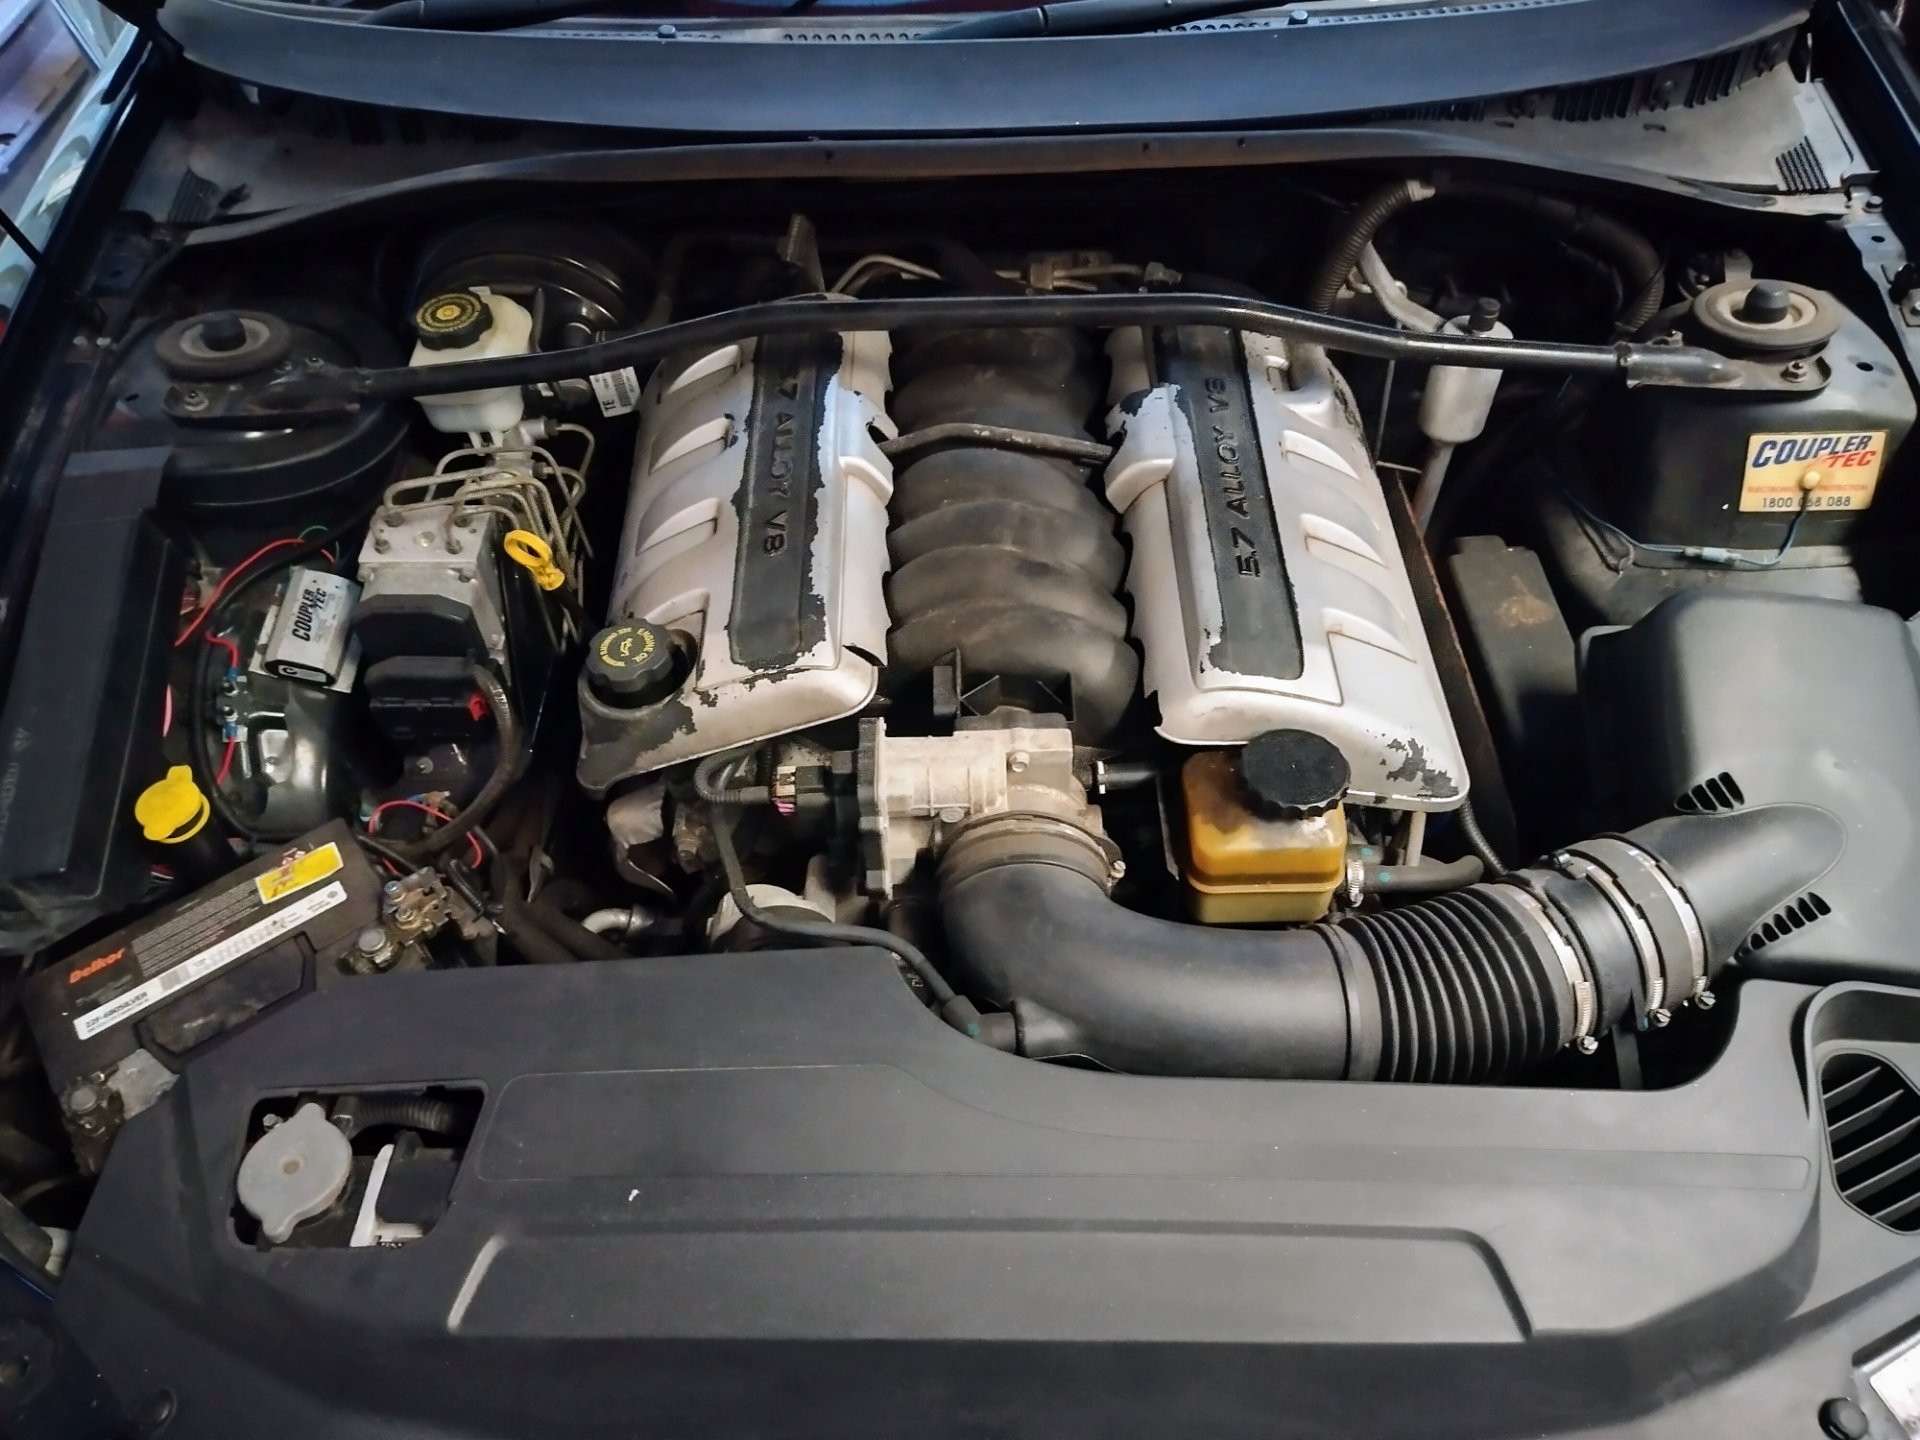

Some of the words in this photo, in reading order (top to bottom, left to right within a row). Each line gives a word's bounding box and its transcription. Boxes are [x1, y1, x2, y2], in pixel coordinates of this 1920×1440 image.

[1204, 376, 1230, 413] V8
[768, 411, 795, 498] ALLOY
[1752, 434, 1873, 469] COUPLER
[1825, 450, 1877, 468] TEC
[1212, 425, 1250, 518] ALLOY
[1762, 497, 1793, 508] 1800
[1826, 496, 1852, 507] 088
[764, 510, 788, 557] V8
[1231, 526, 1261, 578] 5.7
[292, 588, 315, 642] COUPLER
[314, 587, 327, 609] TEC
[632, 652, 648, 662] OIL
[637, 628, 655, 653] ENGINE
